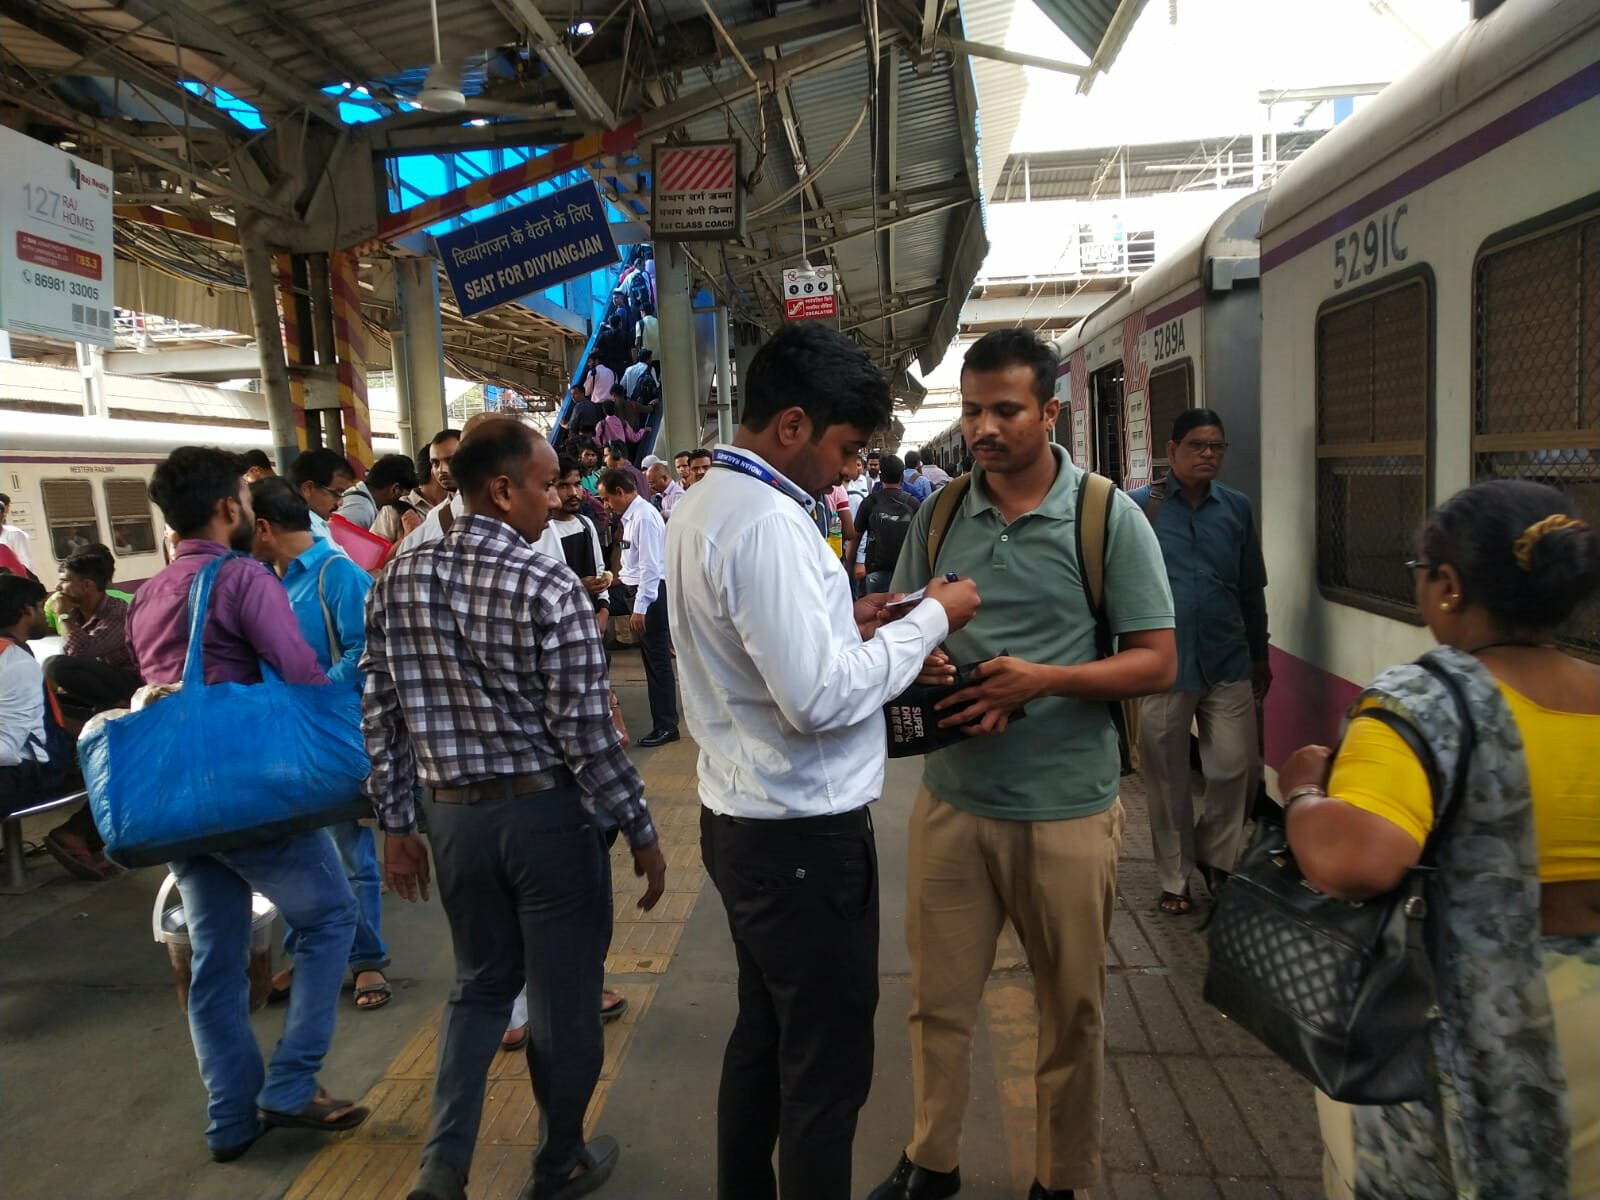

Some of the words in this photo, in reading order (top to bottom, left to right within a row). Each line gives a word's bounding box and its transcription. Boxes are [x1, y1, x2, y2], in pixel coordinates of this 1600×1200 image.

[23, 183, 61, 220] 127
[62, 195, 78, 211] RAJ
[62, 212, 95, 232] HOMES
[452, 233, 511, 268] दिव्यांगजन
[511, 226, 524, 245] के
[525, 215, 552, 239] बैठने
[553, 210, 567, 229] के
[567, 203, 593, 222] लिए
[675, 221, 703, 229] CLASS
[705, 220, 734, 228] COACH
[1333, 204, 1408, 289] 5291C
[464, 275, 496, 300] SEAT
[496, 264, 525, 289] FOR
[524, 234, 603, 279] DIVYANGJAN
[35, 272, 65, 292] 86981
[69, 281, 99, 300] 33005
[1154, 318, 1186, 361] 5289A
[740, 461, 762, 476] INDIAN
[912, 706, 924, 737] SUPER
